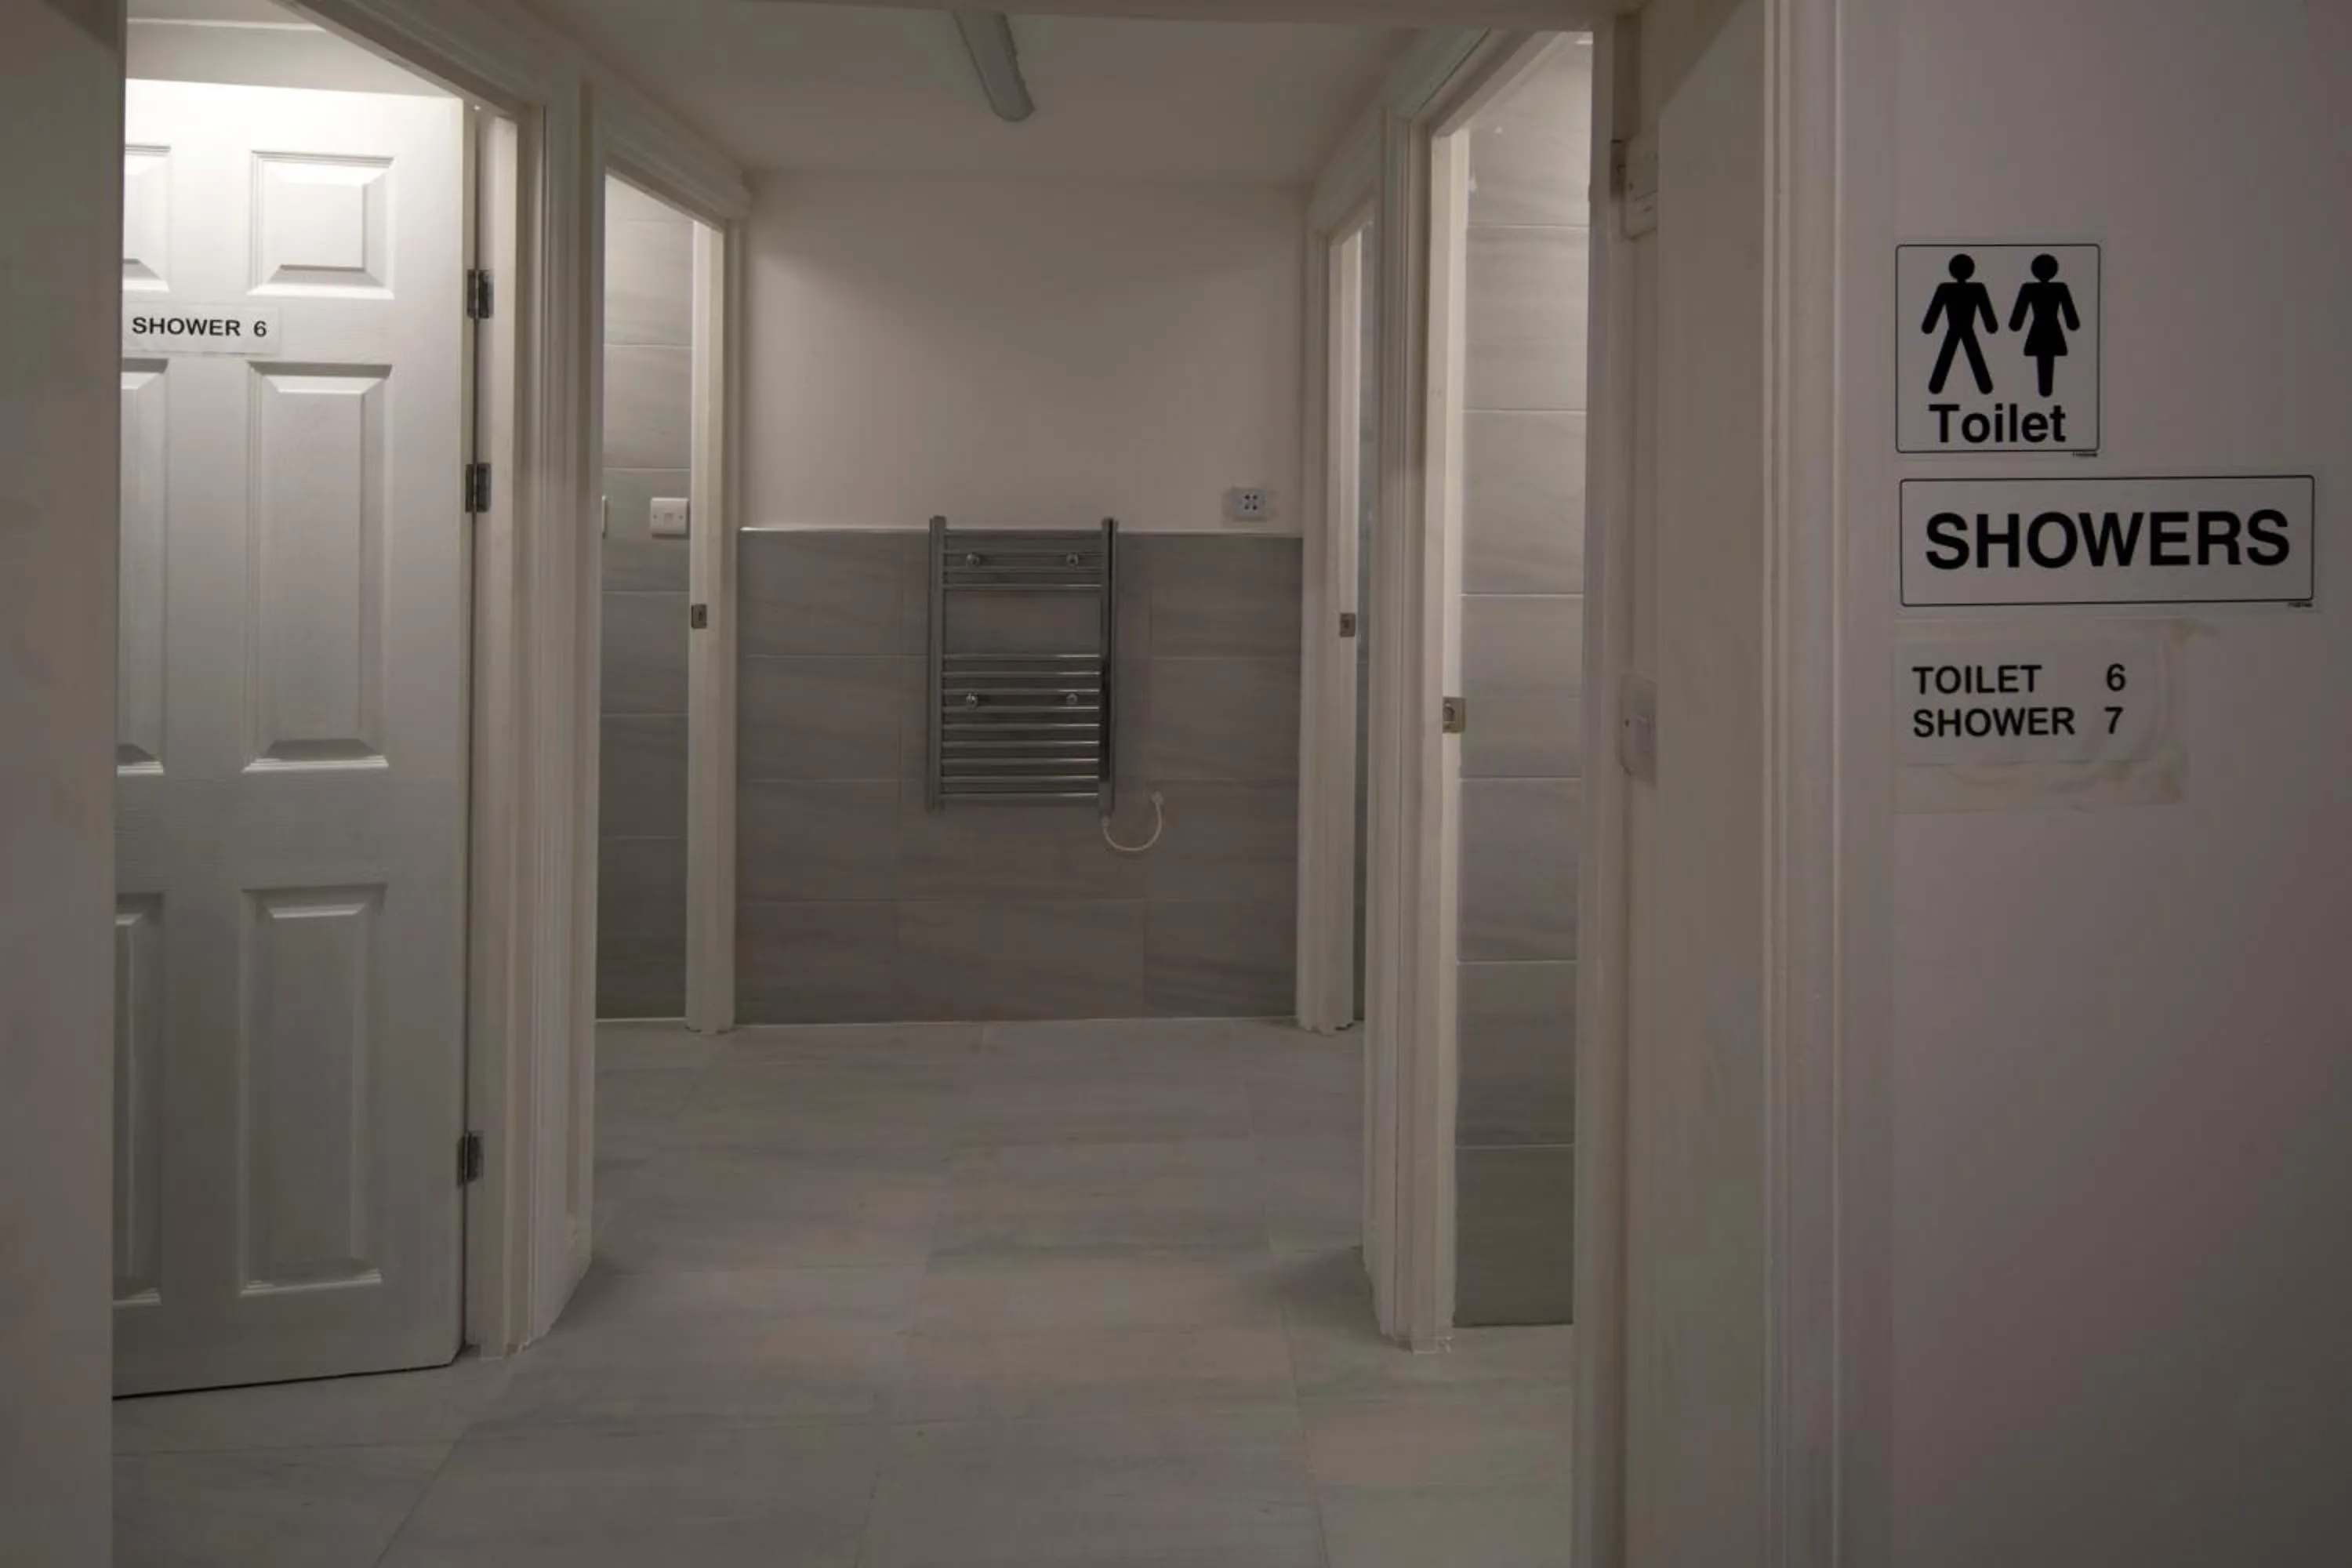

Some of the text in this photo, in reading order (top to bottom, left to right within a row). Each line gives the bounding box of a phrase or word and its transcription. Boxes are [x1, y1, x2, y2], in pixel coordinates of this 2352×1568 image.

[132, 316, 267, 338] SHOWER 6
[1928, 402, 2067, 444] Toilet
[1926, 509, 2290, 570] SHOWERS
[1911, 662, 2127, 695] TOILET 6
[1913, 706, 2125, 739] SHOWER 7
